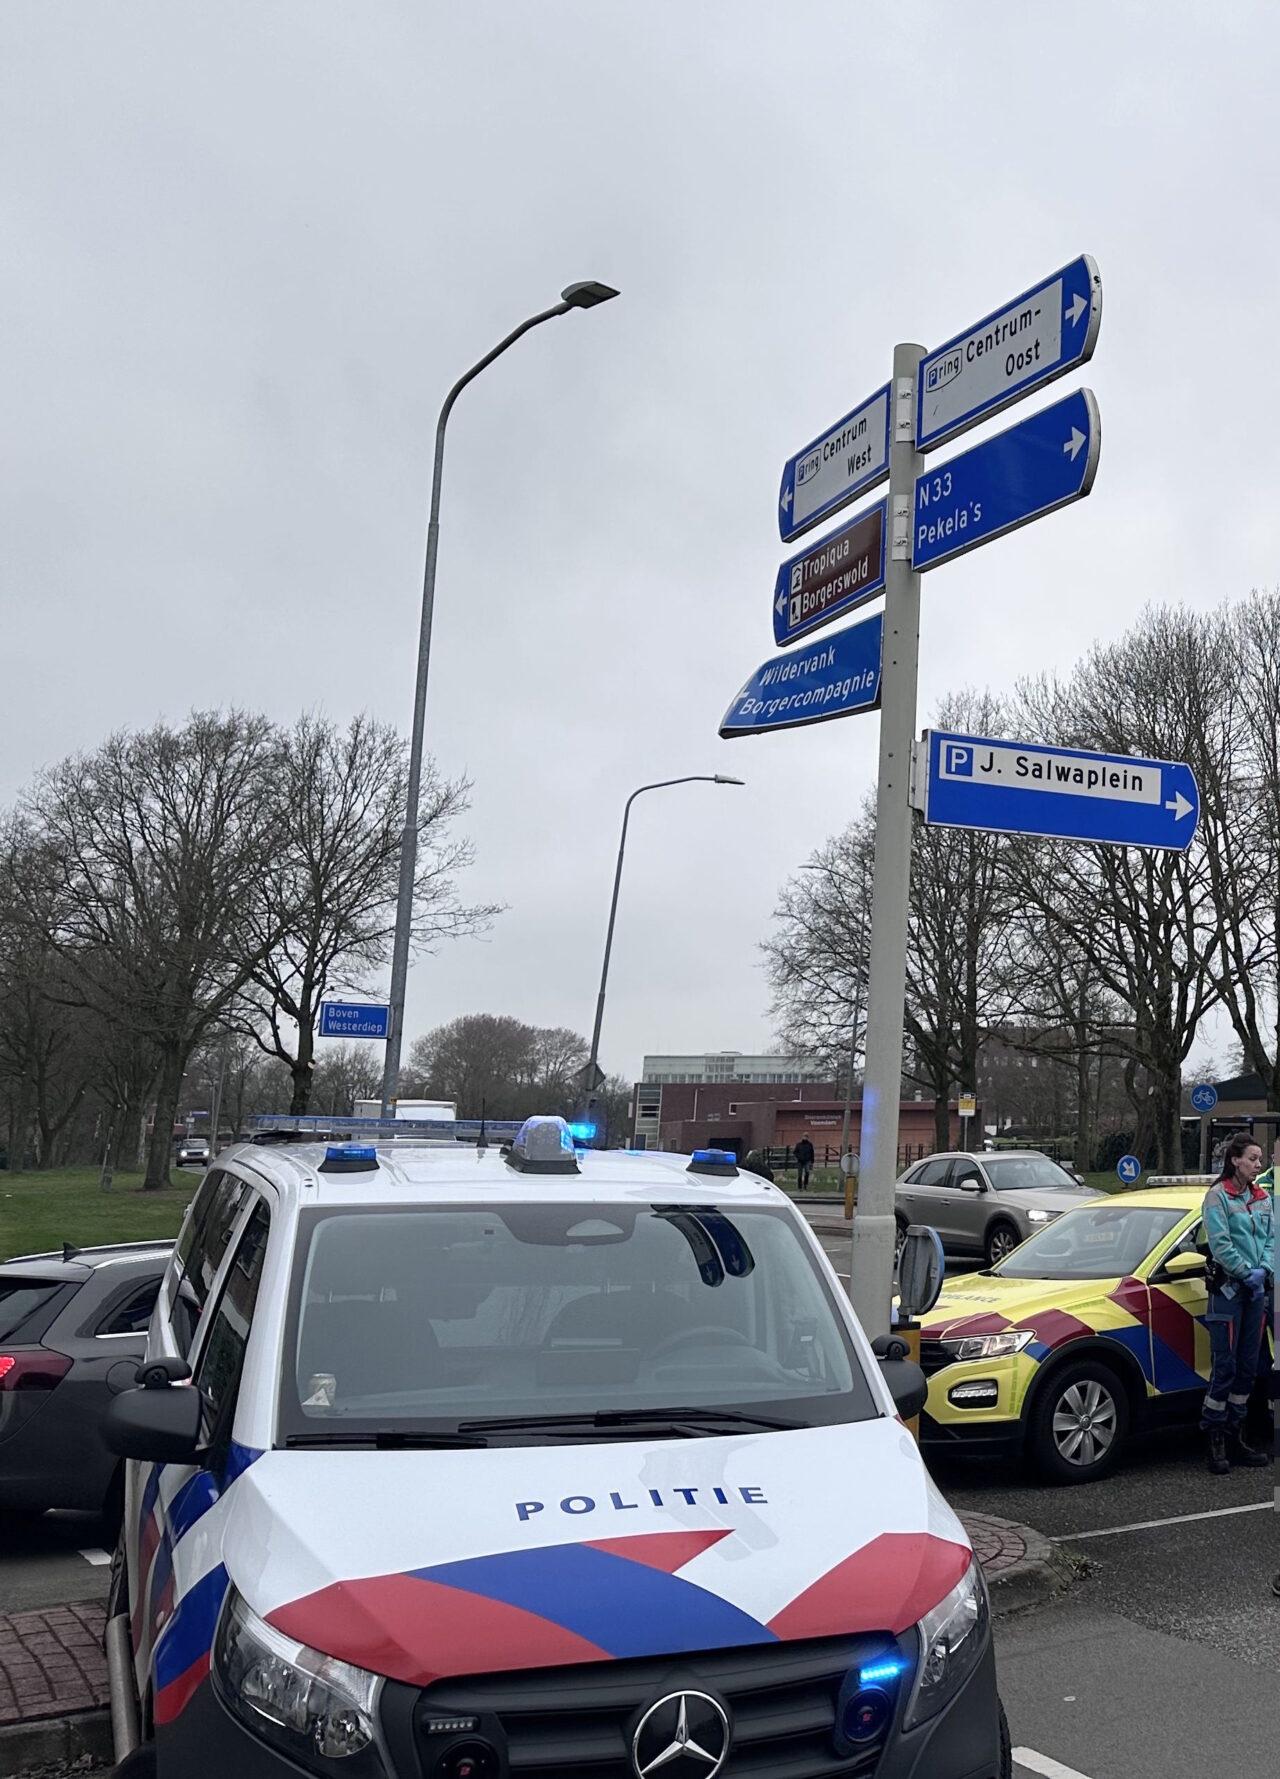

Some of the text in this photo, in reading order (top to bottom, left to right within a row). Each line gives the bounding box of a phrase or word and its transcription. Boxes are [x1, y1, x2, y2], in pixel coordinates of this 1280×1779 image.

[939, 356, 960, 379] ring
[966, 308, 1041, 363] Centrum-
[1005, 338, 1041, 377] Oost
[823, 417, 868, 462] Centrum
[847, 444, 872, 477] West
[918, 501, 982, 549] Pekela's
[803, 539, 850, 581] Tropiqua
[802, 555, 869, 614] Borgerswold
[758, 645, 836, 687] Wildervank
[738, 668, 875, 719] Borgercompagnie
[979, 751, 1002, 774] J.
[1015, 755, 1143, 792] Salwaplein
[328, 1007, 359, 1019] Boven
[328, 1020, 383, 1034] Westerdiep
[515, 1486, 769, 1522] POLITIE
